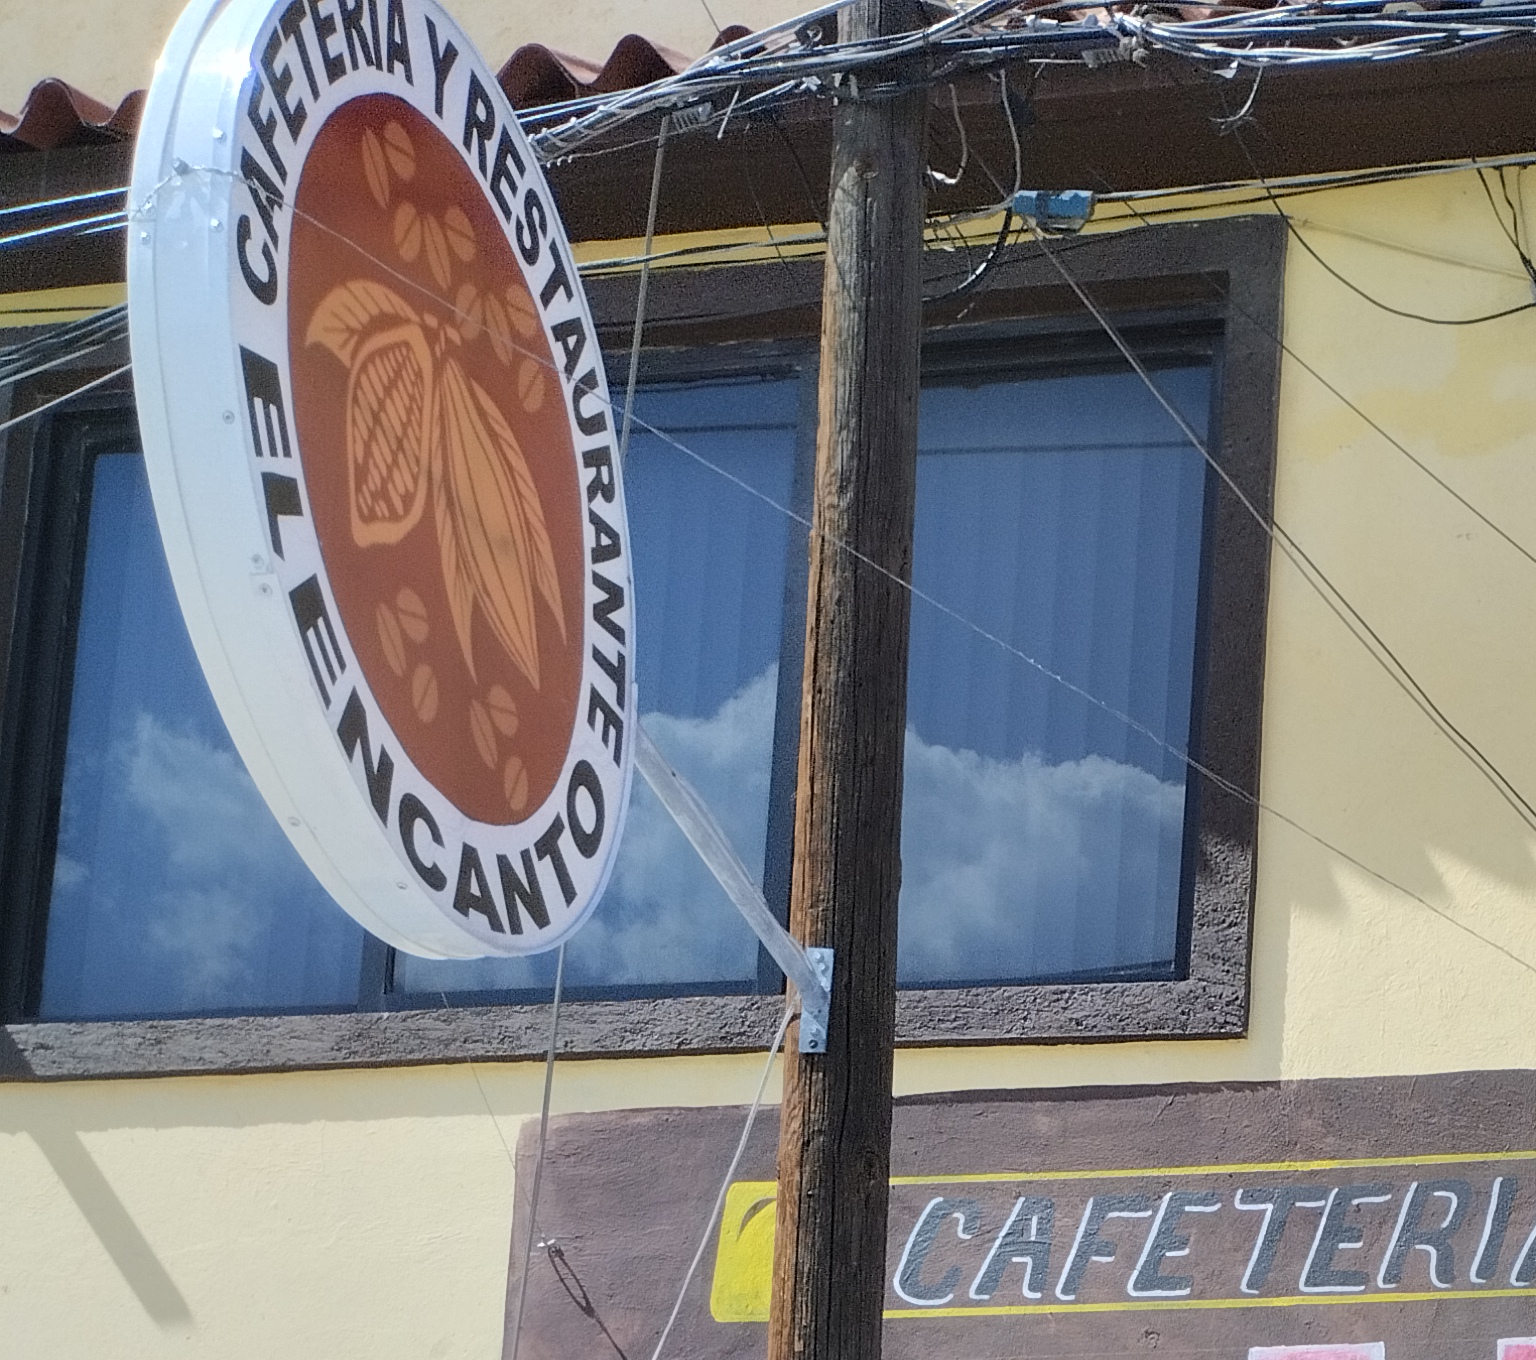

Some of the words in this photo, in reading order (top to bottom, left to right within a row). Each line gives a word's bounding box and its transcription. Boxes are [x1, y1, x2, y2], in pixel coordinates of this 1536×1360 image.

[237, 0, 414, 306] CAFETERIA
[424, 14, 459, 120] Y
[463, 68, 628, 768] RESTAURANTE
[240, 344, 305, 560] EL
[288, 577, 607, 936] ENCANTO
